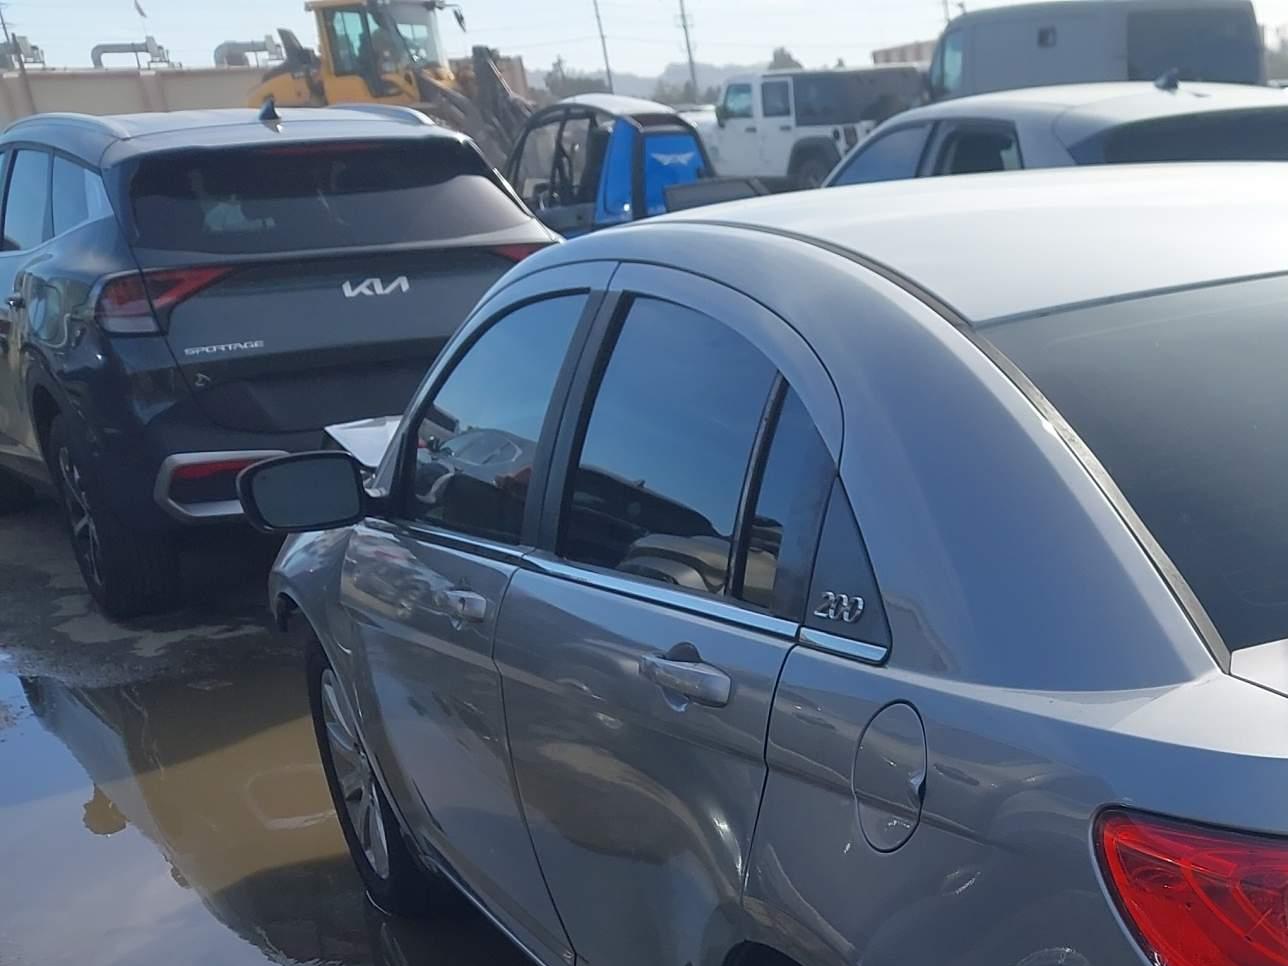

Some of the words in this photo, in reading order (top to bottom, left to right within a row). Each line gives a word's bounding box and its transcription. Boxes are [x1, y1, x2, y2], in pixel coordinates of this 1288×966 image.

[342, 276, 409, 297] KIA
[184, 340, 265, 355] SPORTAGE
[814, 591, 864, 622] 200
